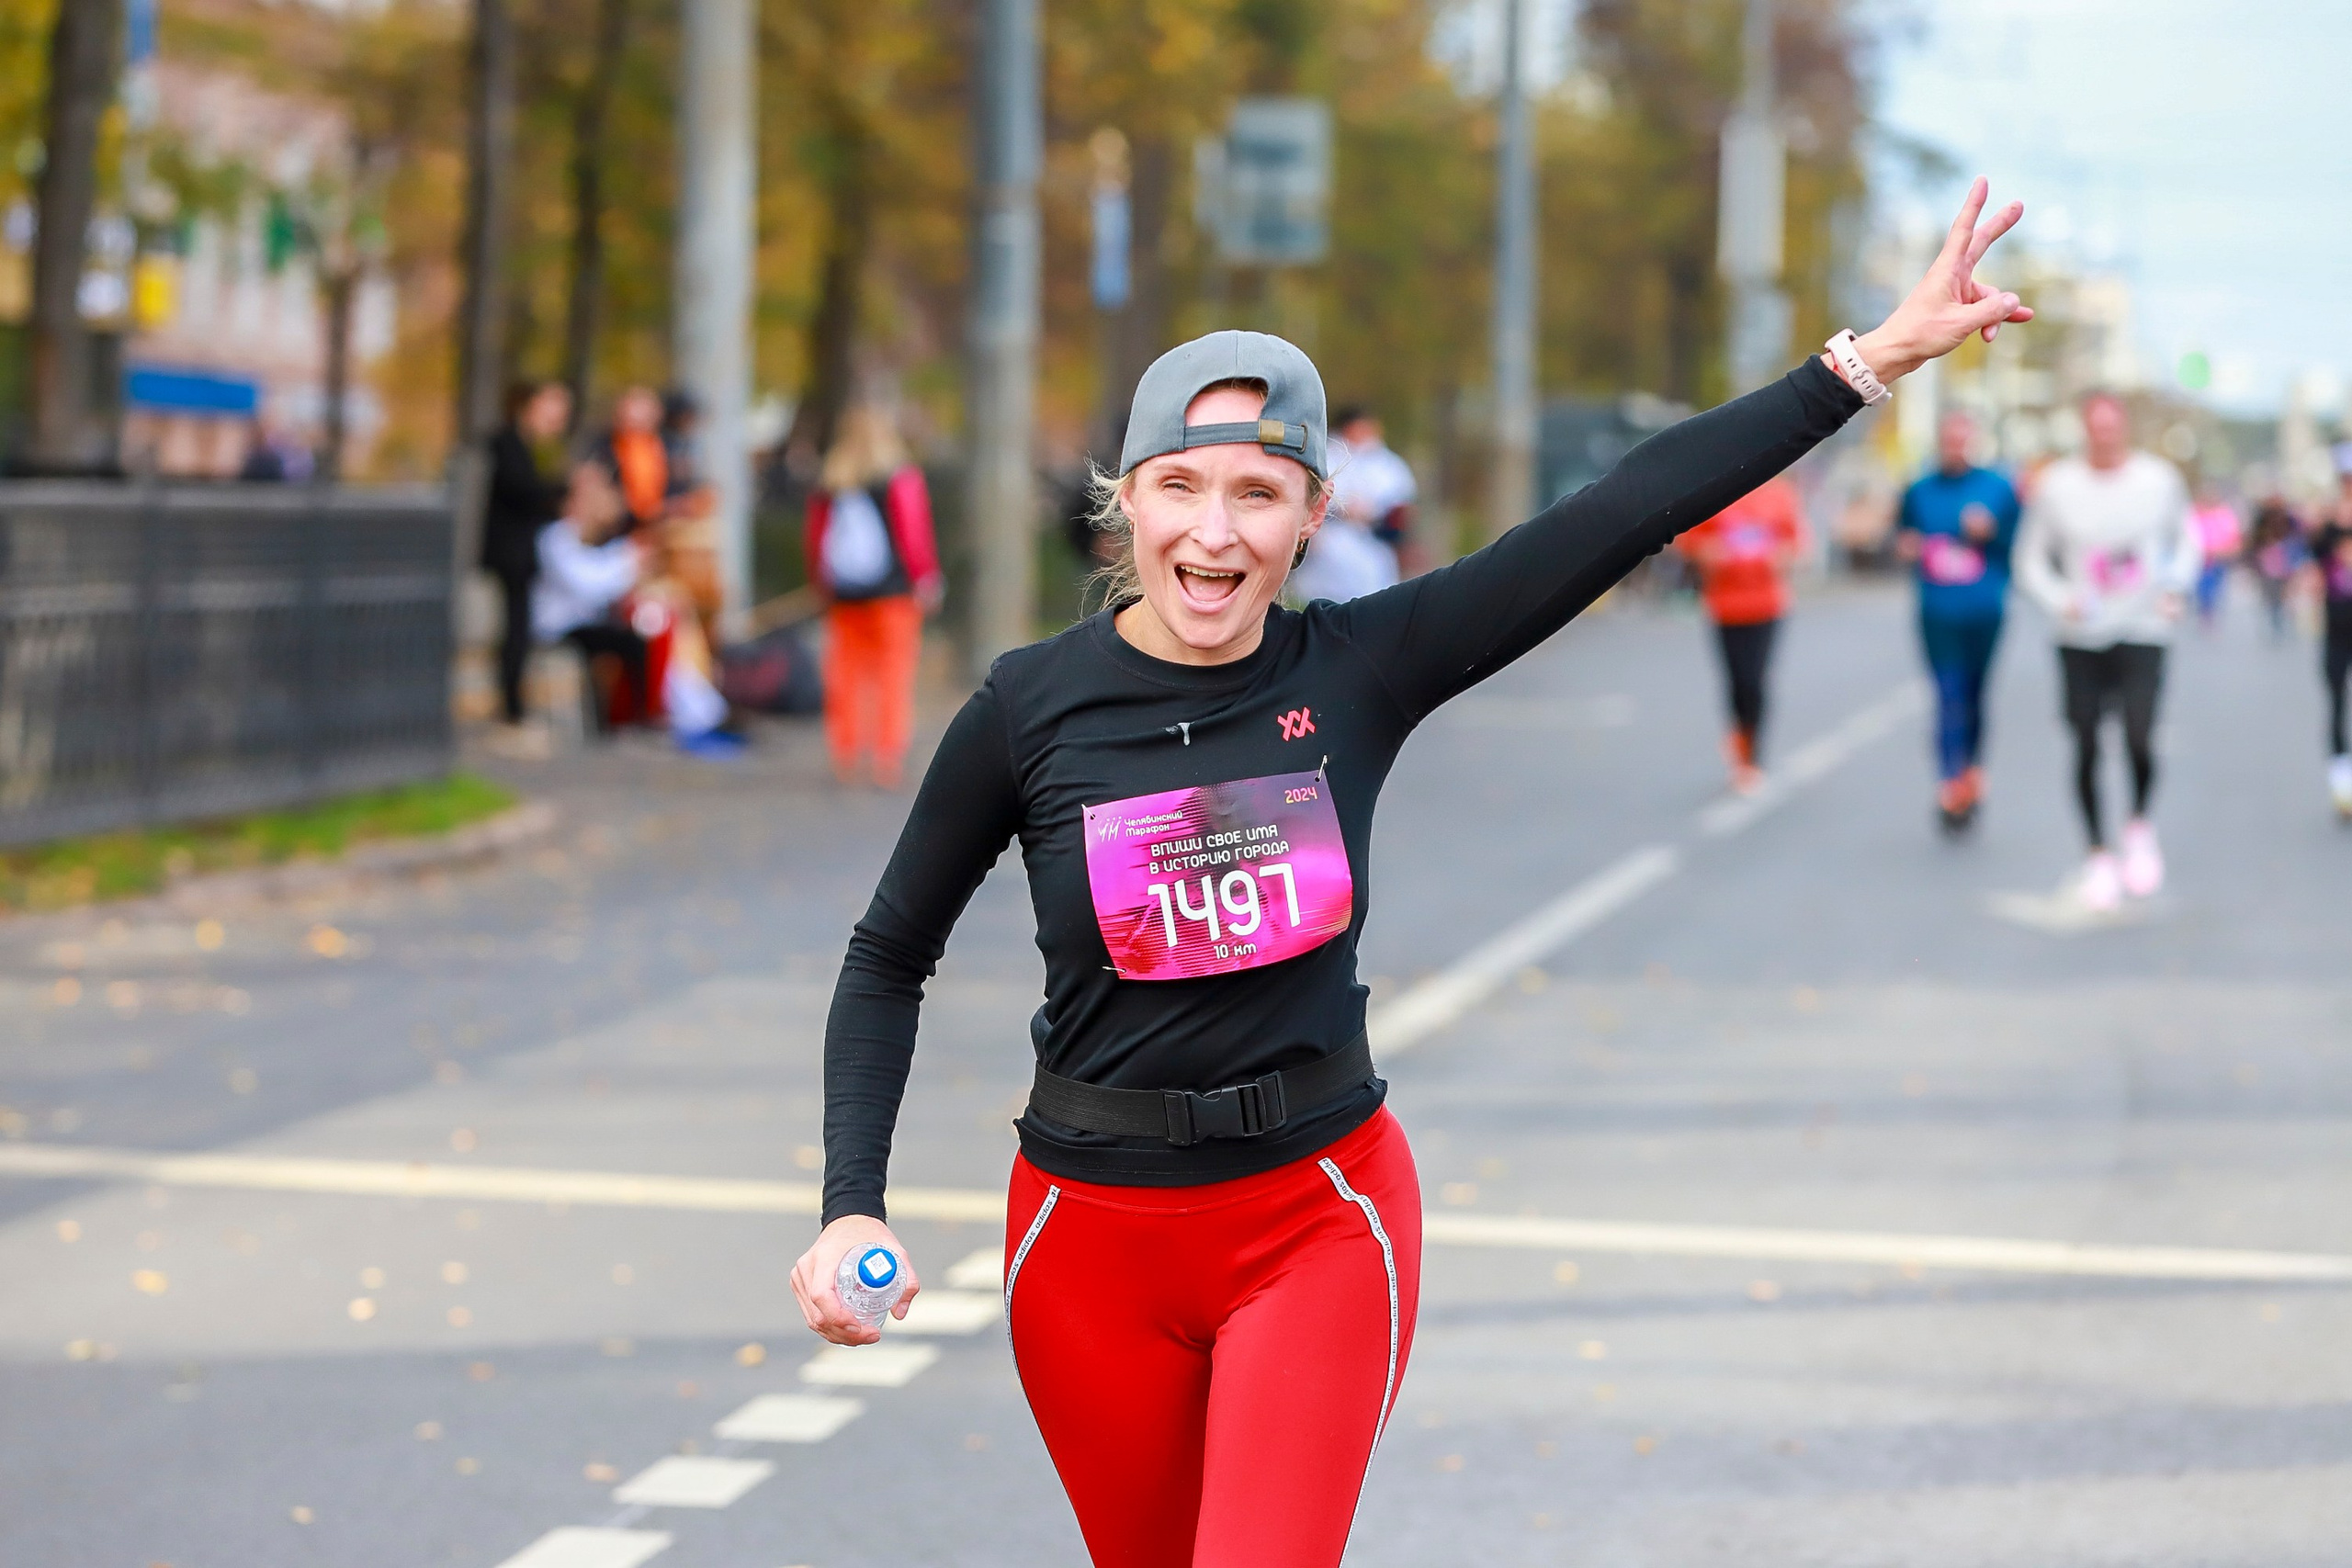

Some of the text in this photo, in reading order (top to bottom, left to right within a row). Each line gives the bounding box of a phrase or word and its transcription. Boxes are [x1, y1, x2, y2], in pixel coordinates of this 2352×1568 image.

[1284, 787, 1317, 804] 2024
[1124, 810, 1183, 827] Челябинский
[1125, 824, 1170, 838] Марафон
[1150, 825, 1278, 857] ВПИШИ СВОЕ ИМЯ
[1149, 840, 1290, 874] В ИСТОРИЮ ГОРОДА
[1148, 863, 1301, 947] 1497
[1213, 945, 1229, 959] 10
[1339, 1181, 1356, 1200] didas
[1360, 1196, 1378, 1224] adidas
[1007, 1200, 1053, 1292] adidas adidas adidas
[1376, 1226, 1391, 1256] adidas
